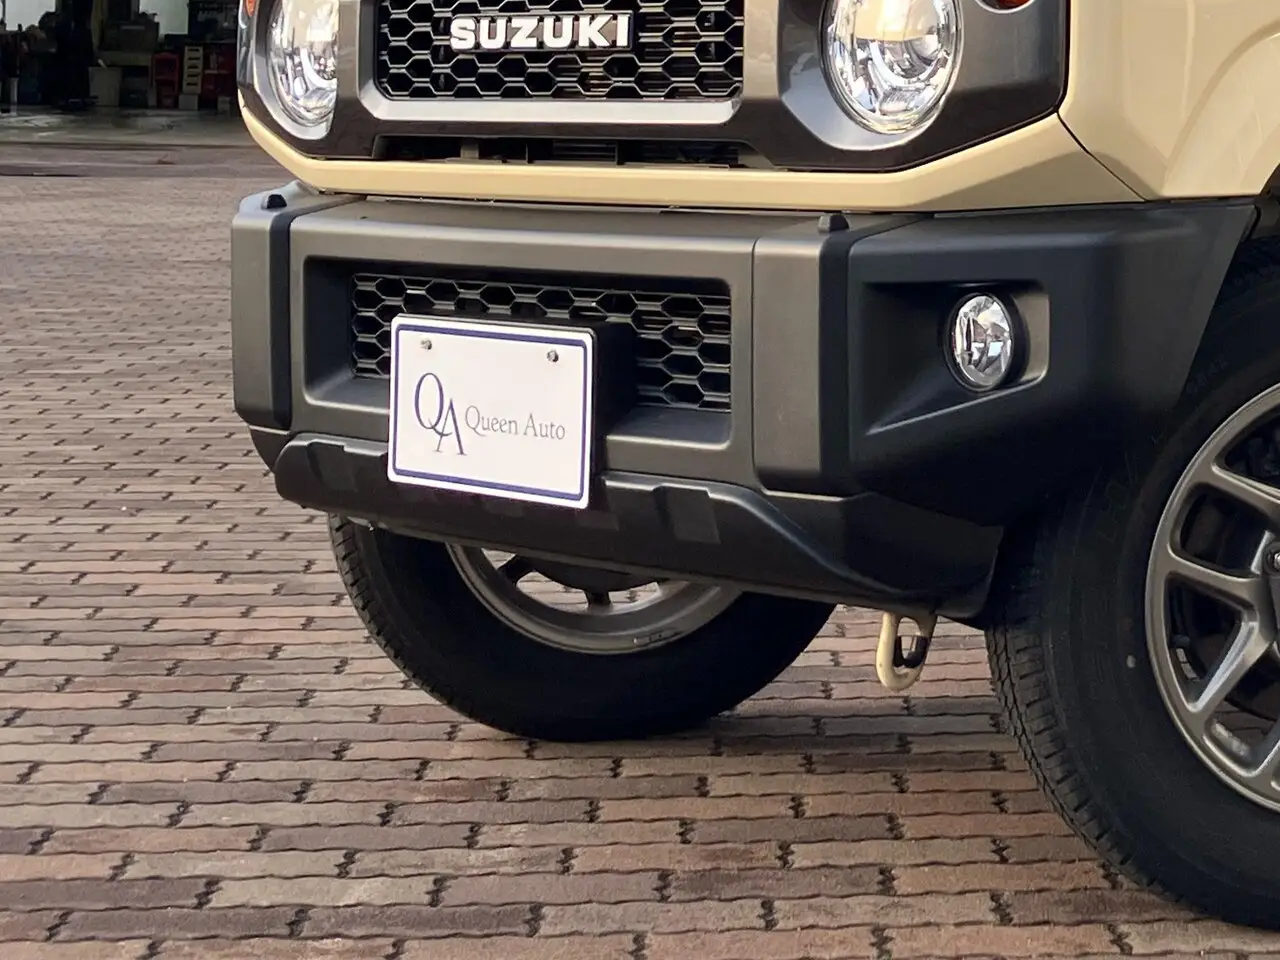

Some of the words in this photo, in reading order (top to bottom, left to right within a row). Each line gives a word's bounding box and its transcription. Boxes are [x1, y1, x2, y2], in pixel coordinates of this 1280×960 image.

[450, 14, 630, 50] SUZUKI
[465, 405, 518, 436] Queen
[523, 413, 566, 440] Auto
